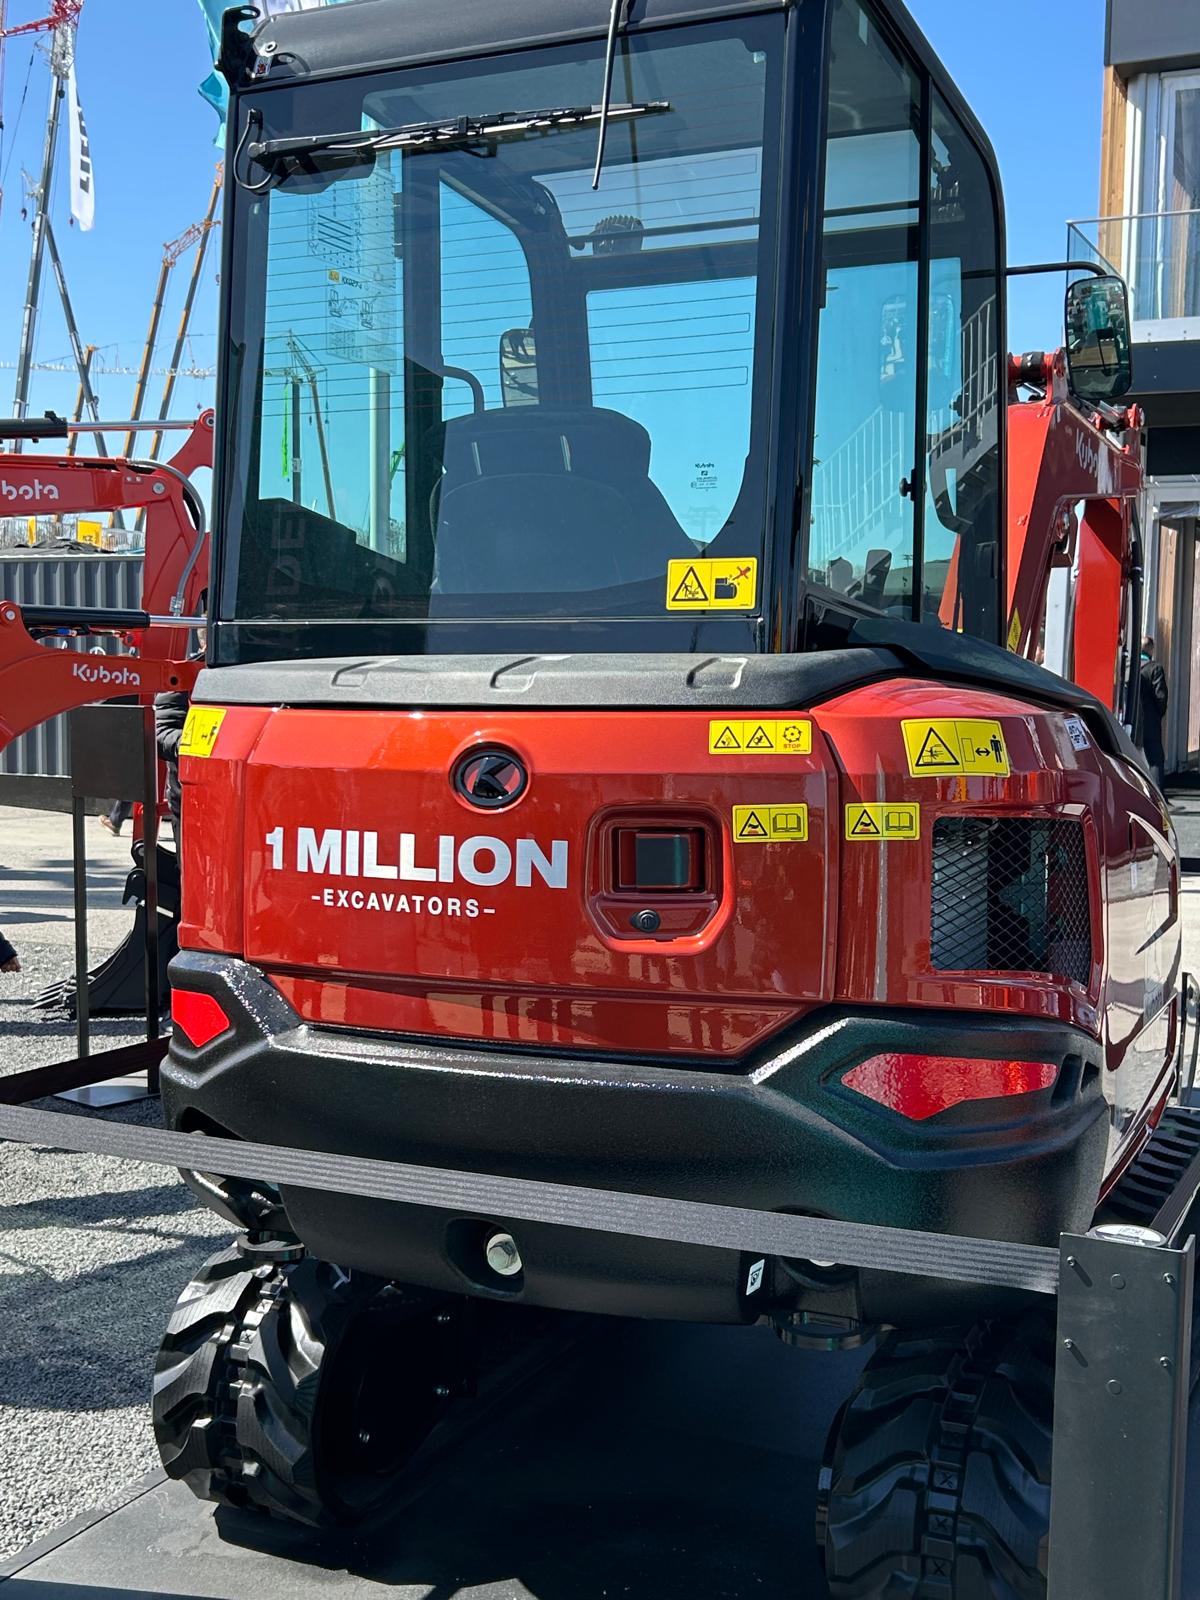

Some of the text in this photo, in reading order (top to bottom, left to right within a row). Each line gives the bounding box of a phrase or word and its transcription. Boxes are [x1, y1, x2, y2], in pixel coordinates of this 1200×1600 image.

[73, 663, 140, 686] Kubota
[265, 826, 568, 889] 1 MILLION
